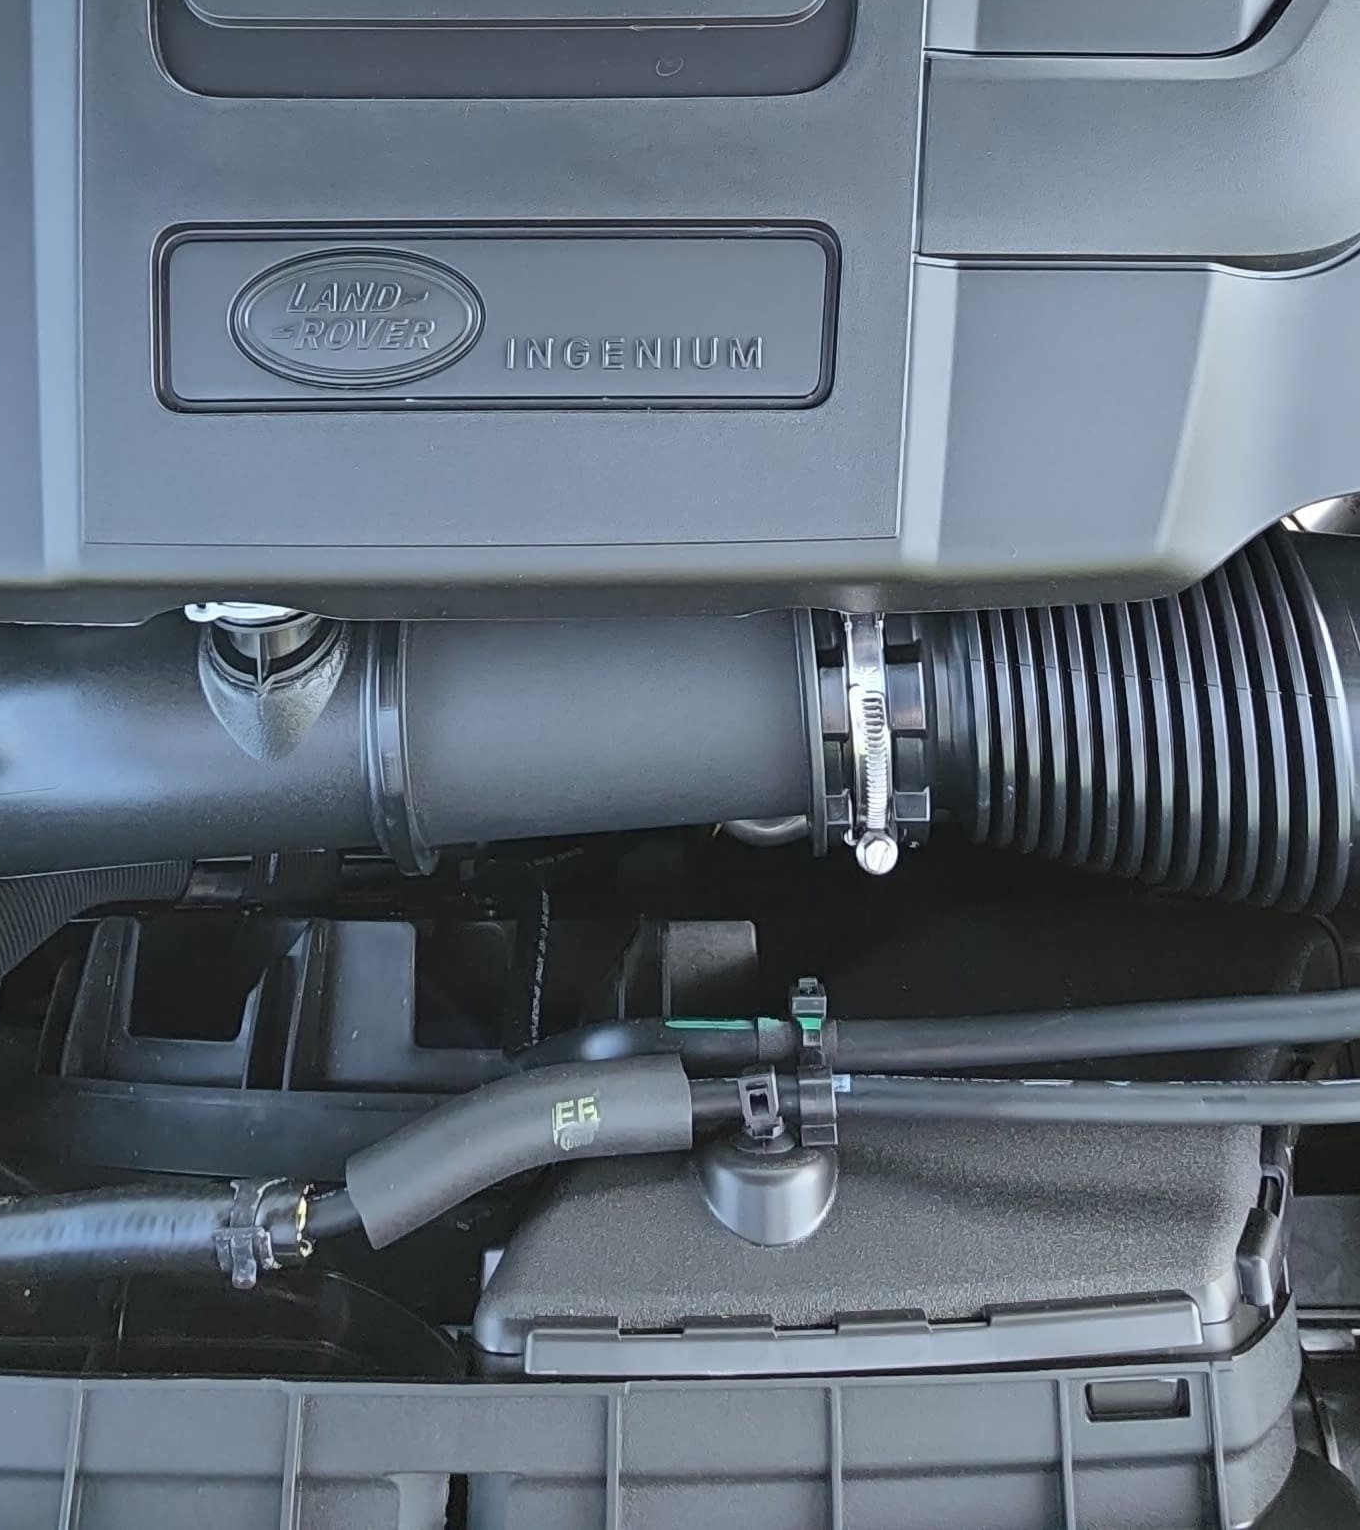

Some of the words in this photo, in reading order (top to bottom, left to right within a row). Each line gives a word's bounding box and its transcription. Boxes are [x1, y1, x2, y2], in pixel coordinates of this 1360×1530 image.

[286, 281, 403, 314] LAND
[293, 317, 438, 351] ROVER
[503, 335, 765, 371] INGENIUM
